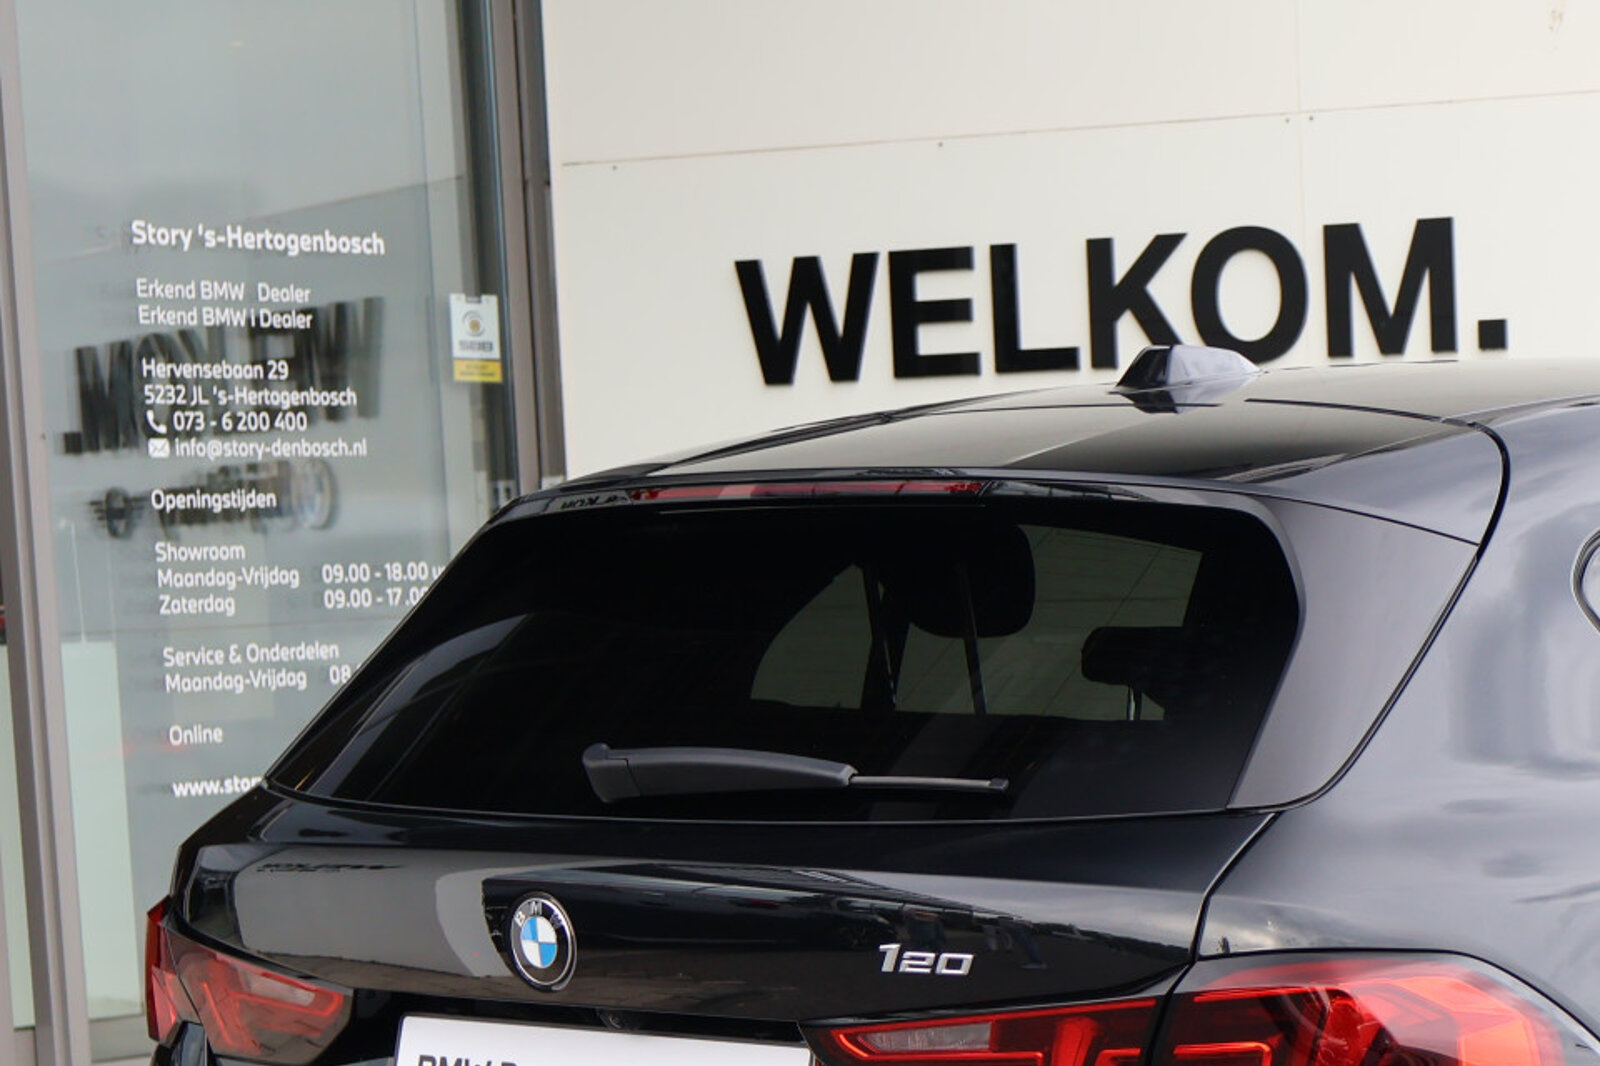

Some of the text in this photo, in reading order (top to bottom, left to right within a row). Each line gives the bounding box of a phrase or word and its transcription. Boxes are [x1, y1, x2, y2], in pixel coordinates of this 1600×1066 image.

[131, 219, 386, 256] Story 's-Hertogenbosch
[136, 278, 311, 303] Erkend BMW Dealer
[735, 216, 1508, 386] WELKOM.
[138, 304, 313, 330] Erkend BMW i Dealer
[141, 357, 289, 381] Hervensebaan 29
[144, 384, 357, 411] 5232 JL 's-Hertogenbosch
[172, 411, 205, 431] 073
[221, 411, 233, 432] 6
[237, 411, 271, 432] 200
[274, 411, 308, 432] 400
[174, 437, 368, 461] info@story-denbosch.nl
[151, 489, 278, 514] Openingstijden
[155, 541, 246, 563] Showroom
[157, 565, 300, 589] Maandag-Vrijdag
[322, 563, 372, 585] 09.00
[384, 561, 429, 582] 18.00
[159, 593, 236, 617] Zaterdag
[324, 588, 373, 610] 09.00
[163, 640, 340, 668] Service & Onderdelen
[165, 668, 307, 694] Maandag-Vrijdag
[169, 724, 224, 746] Online
[879, 943, 975, 976] 120
